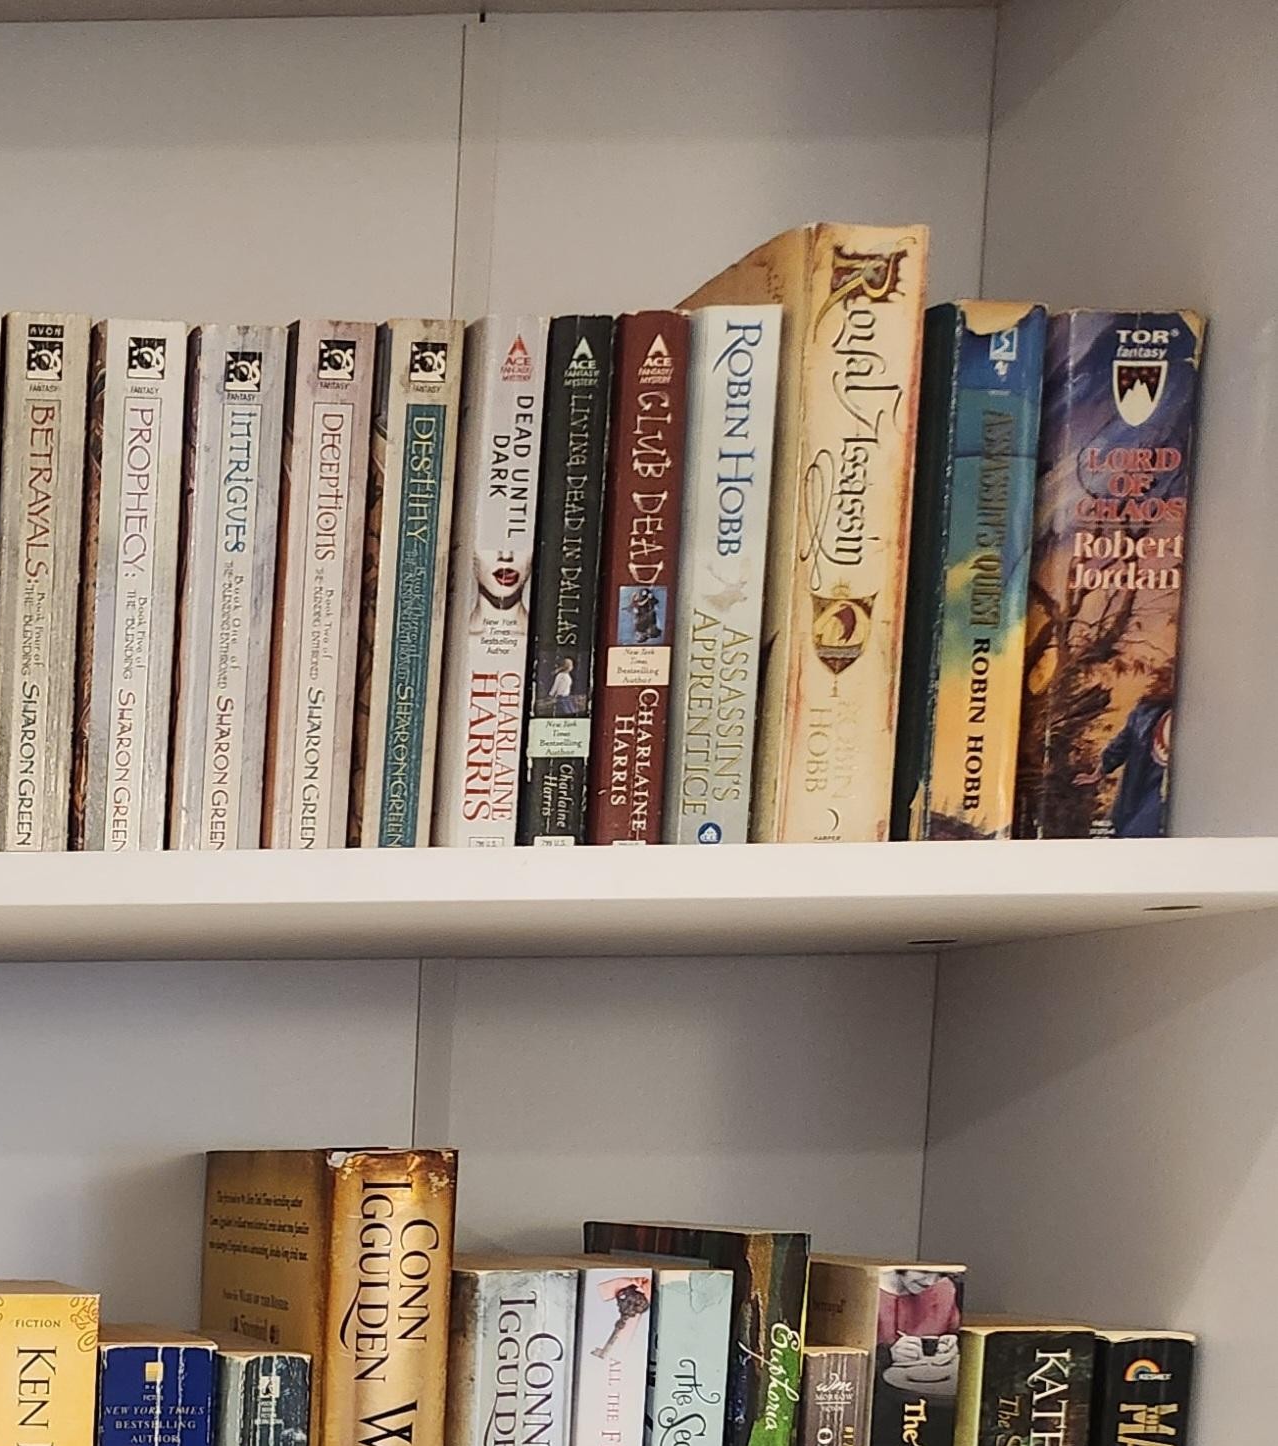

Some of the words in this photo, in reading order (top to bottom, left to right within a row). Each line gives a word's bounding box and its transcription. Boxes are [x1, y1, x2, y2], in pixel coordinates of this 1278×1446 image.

[713, 319, 764, 439] ROBIN
[489, 434, 512, 498] DARK
[512, 396, 534, 455] DEAD
[506, 463, 530, 539] UNTIL
[716, 449, 756, 557] HOBB
[1069, 560, 1183, 591] Jordan
[1073, 532, 1183, 560] Robert
[463, 672, 499, 821] HARRIS
[491, 672, 522, 821] CHARLAINE
[682, 609, 720, 816] APPRENTICE
[715, 625, 748, 802] ASSASSIN'S
[14, 1318, 61, 1329] FICTION
[16, 1345, 58, 1431] KEN
